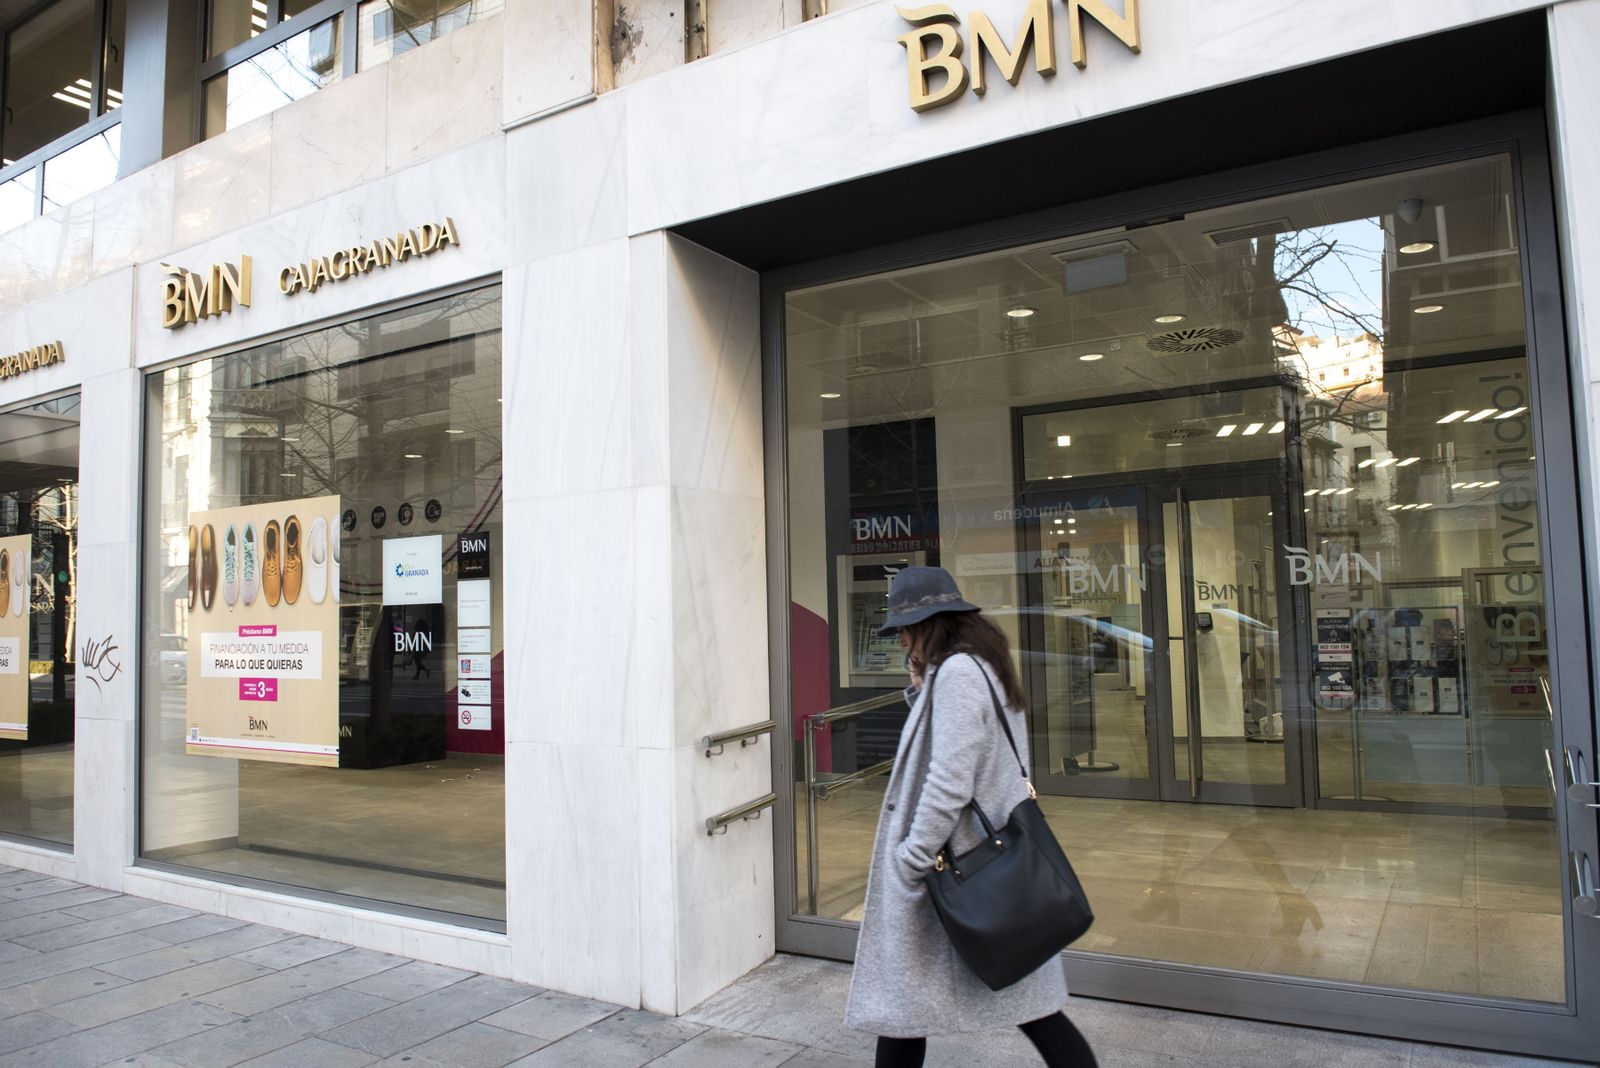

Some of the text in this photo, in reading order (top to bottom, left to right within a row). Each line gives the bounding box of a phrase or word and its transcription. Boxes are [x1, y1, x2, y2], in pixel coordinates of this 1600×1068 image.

[896, 0, 1140, 113] BMN
[160, 216, 459, 330] BMN CAJAGRANADA
[854, 514, 911, 541] BMN
[461, 538, 486, 553] BMN
[1066, 560, 1147, 594] BMN
[1284, 549, 1382, 586] BMN
[1196, 581, 1243, 600] BMN
[268, 644, 277, 654] TU
[279, 643, 309, 654] MEDIDA
[393, 630, 432, 652] BMN
[215, 659, 303, 670] PARA LO QUE QUIERAS
[257, 681, 266, 698] 3
[249, 718, 268, 731] BMN
[340, 725, 352, 738] MN
